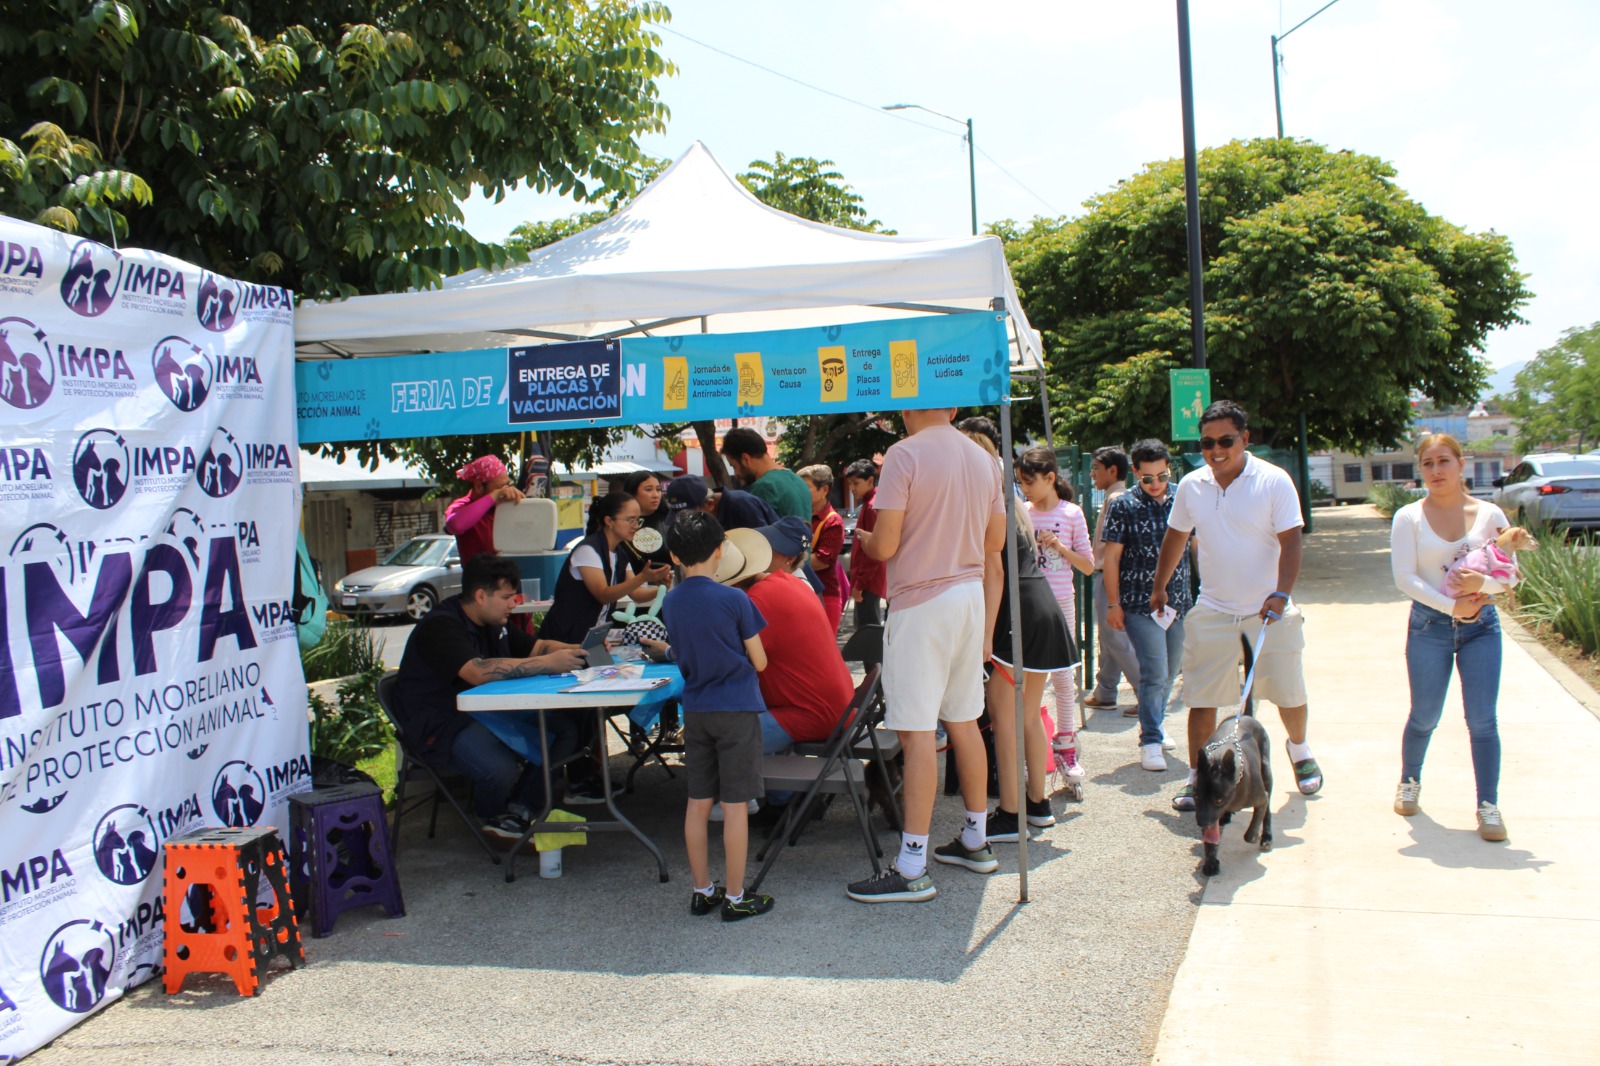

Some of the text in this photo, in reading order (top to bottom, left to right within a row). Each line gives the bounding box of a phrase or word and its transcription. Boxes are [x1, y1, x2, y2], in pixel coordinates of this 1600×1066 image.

[0, 240, 43, 279] PA
[124, 263, 186, 300] IMPA
[122, 293, 187, 309] INSTITUTO MORELIANO
[242, 283, 292, 311] IMPA
[121, 301, 129, 309] DE
[852, 348, 881, 359] Entrega
[927, 354, 970, 365] Actividades
[58, 344, 135, 380] IMPA
[694, 363, 731, 374] Jornada de
[863, 362, 873, 370] de
[519, 363, 610, 382] ENTREGA DE
[771, 367, 807, 376] Venta con
[935, 368, 963, 379] Lúdicas
[62, 379, 137, 390] INSTITUTO MORELIANO
[692, 376, 733, 387] Vacunación
[779, 380, 802, 389] Causa
[856, 375, 880, 384] Placas
[63, 388, 72, 396] DE
[528, 378, 603, 396] PLACAS Y
[856, 388, 880, 397] Juskas
[311, 389, 355, 402] MORELIANO
[356, 390, 366, 400] DE
[391, 380, 457, 413] FERIA
[462, 376, 493, 408] DE
[513, 392, 618, 415] VACUNACIÓN
[330, 404, 361, 417] ANIMAL
[134, 446, 196, 476] IMPA
[246, 444, 293, 469] IMPA
[15, 483, 53, 491] MORELIANO
[134, 477, 166, 486] INSTITUTO
[31, 492, 55, 500] ANIMAL
[135, 662, 260, 720] MORELIANO
[27, 714, 192, 793] PROTECCIÓN
[196, 695, 265, 738] ANIMAL
[265, 754, 312, 792] IMPA
[158, 793, 202, 838] IMPA
[34, 878, 77, 901] MORELIANO
